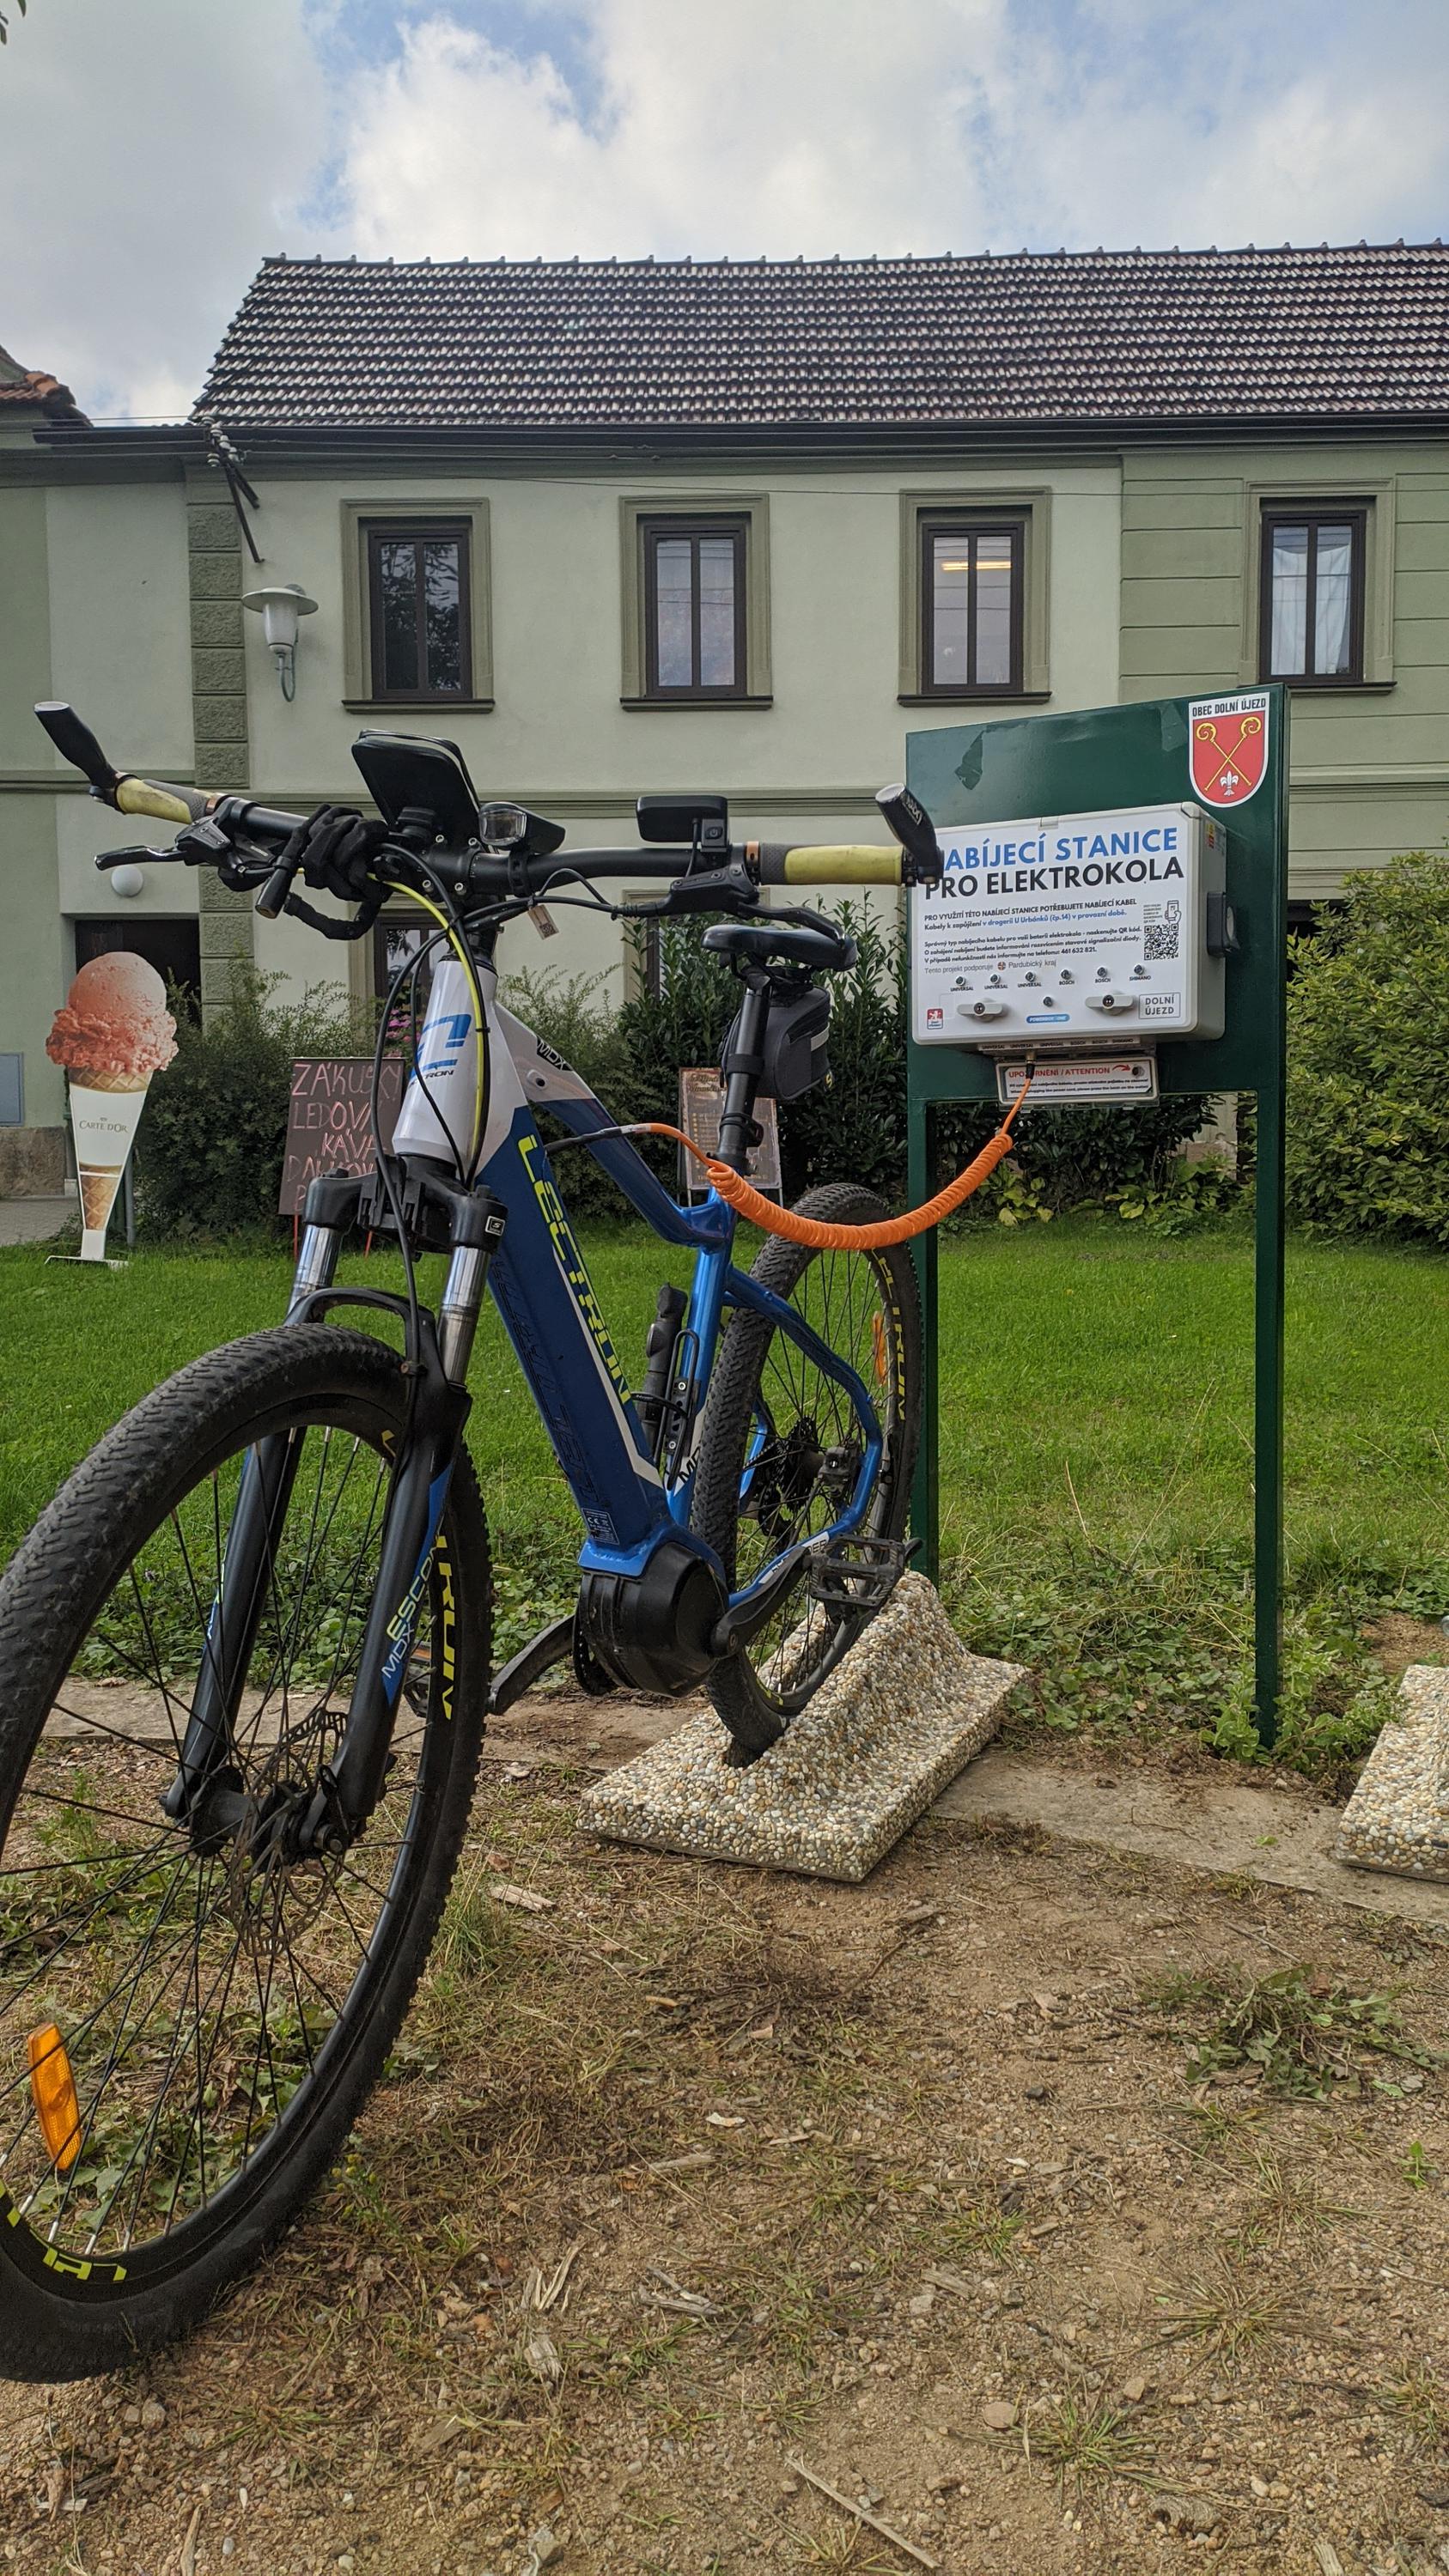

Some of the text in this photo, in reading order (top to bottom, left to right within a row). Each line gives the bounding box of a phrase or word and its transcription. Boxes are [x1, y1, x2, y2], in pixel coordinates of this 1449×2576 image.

[1192, 698, 1266, 717] OBEC DOLNÍ ÚJEZD
[944, 827, 1178, 872] ABÍJECÍ STANICE
[925, 856, 1184, 900] PRO ELEKTROKOLA
[939, 910, 964, 920] VYUŽITÍ
[982, 907, 1010, 916] NABÍJECÍ
[1011, 906, 1038, 914] STANICE
[1039, 903, 1083, 912] POTŘEBUJETE
[1085, 898, 1114, 908] NABÍJECÍ
[988, 918, 1014, 927] drogerii
[942, 965, 963, 974] projekt
[964, 963, 994, 972] podporuje
[1008, 960, 1042, 969] Pardubický
[1145, 994, 1174, 1005] DOLNÍ
[1145, 1006, 1174, 1015] ÚJEZD
[538, 1041, 567, 1071] MDX
[1008, 1069, 1059, 1078] UPORNĚNÍ
[1065, 1067, 1111, 1077] ATTENTION
[79, 1120, 104, 1130] CARTE
[381, 1623, 415, 1680] MDX
